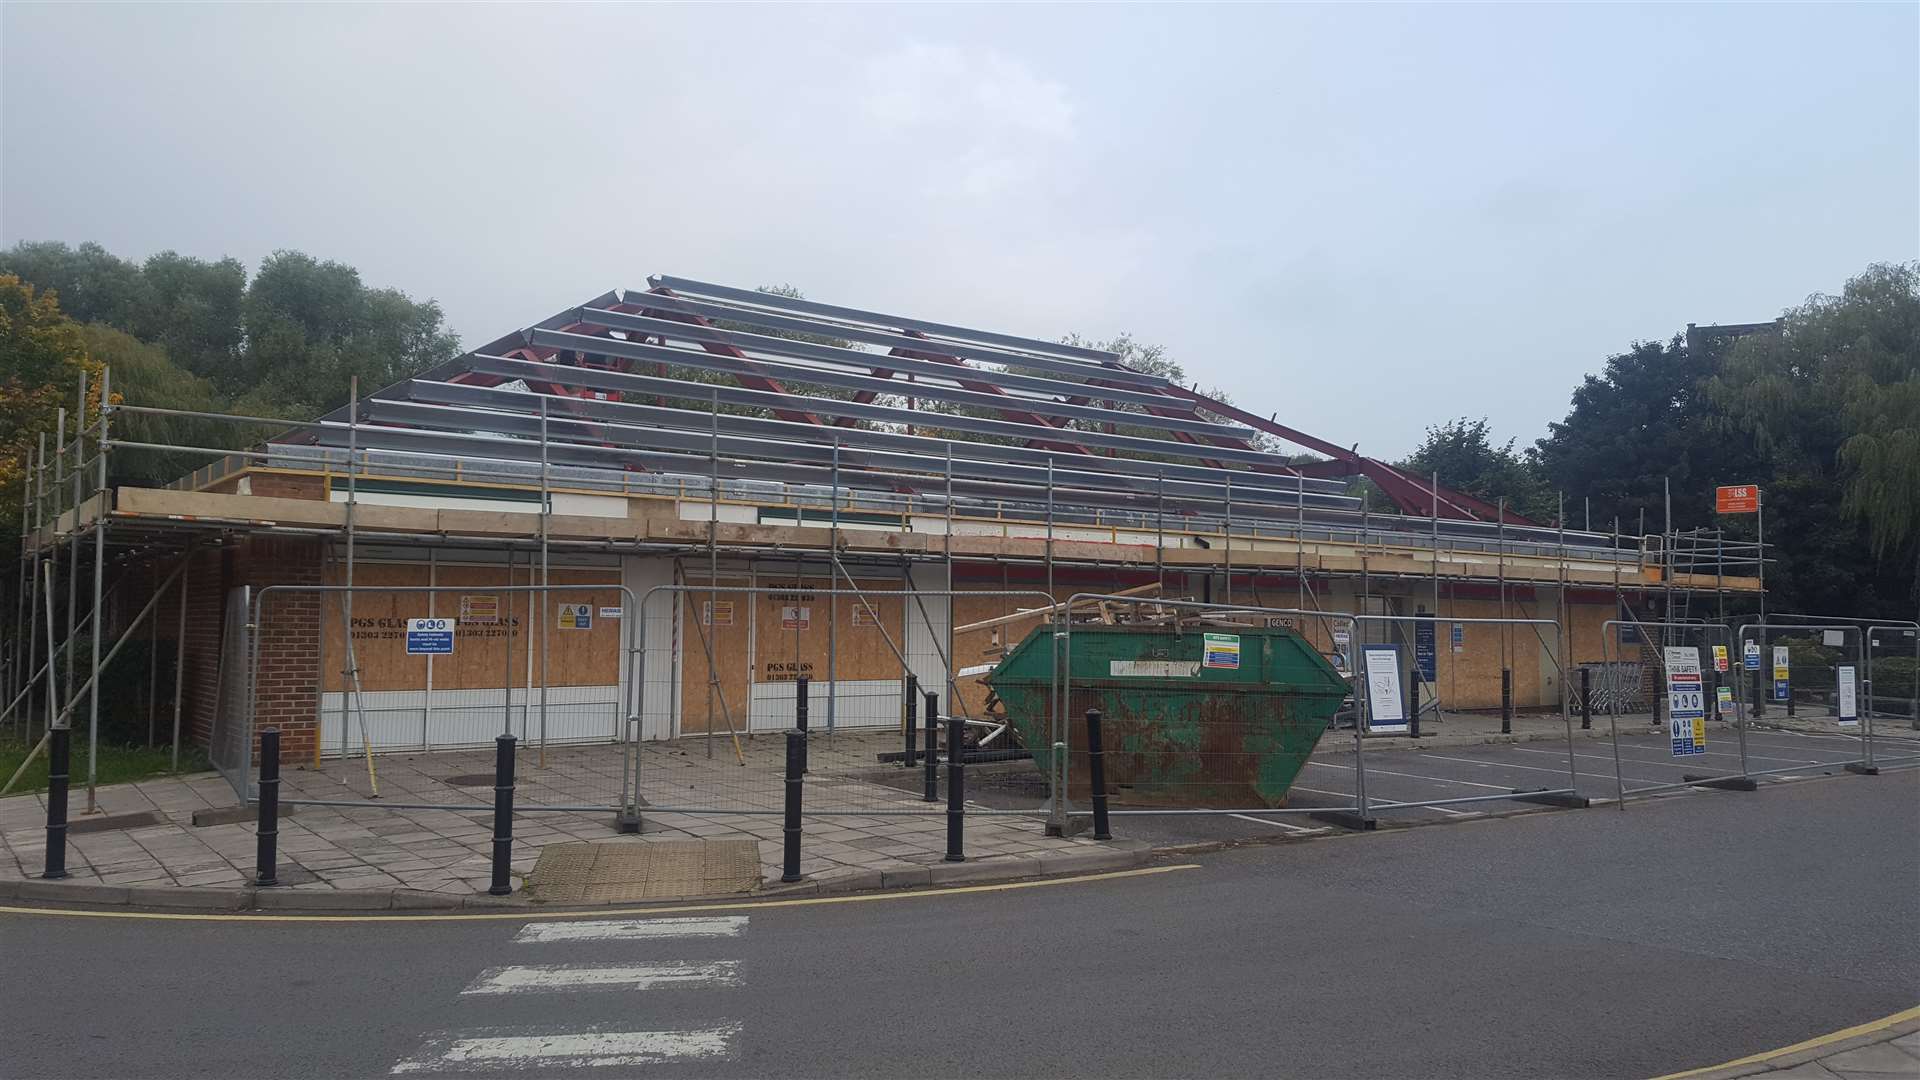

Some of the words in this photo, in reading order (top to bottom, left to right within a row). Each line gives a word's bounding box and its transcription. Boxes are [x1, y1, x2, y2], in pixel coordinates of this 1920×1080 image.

[351, 617, 375, 628] PGS
[379, 617, 408, 628] GLAS
[767, 662, 784, 671] PGS
